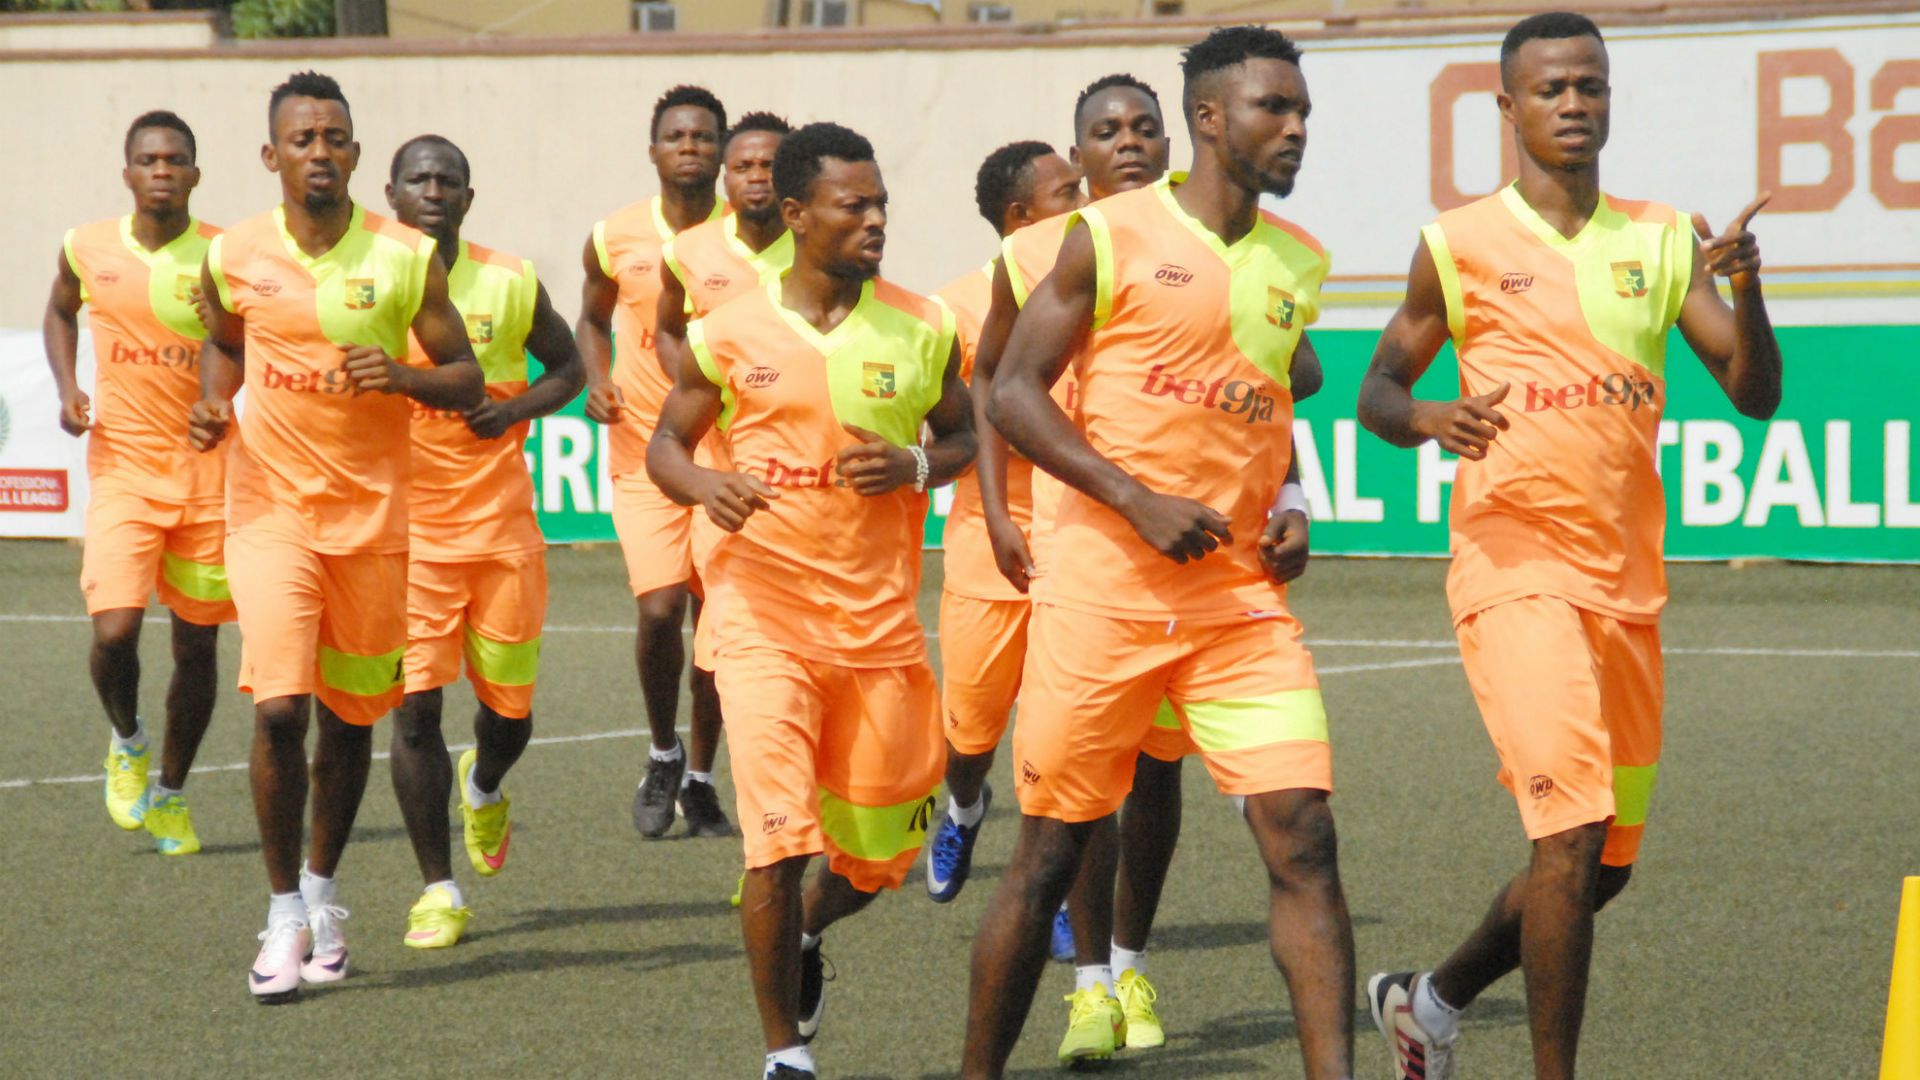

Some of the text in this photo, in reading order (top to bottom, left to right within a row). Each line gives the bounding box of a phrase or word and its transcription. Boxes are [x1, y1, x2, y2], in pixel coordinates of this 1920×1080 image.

[1155, 266, 1194, 285] OWU
[1500, 275, 1534, 292] OWU
[264, 361, 352, 395] bet9
[745, 370, 780, 386] OWU
[1141, 364, 1275, 424] bet9ja
[1524, 373, 1655, 413] bet9ja
[1530, 777, 1553, 797] OWU
[762, 814, 787, 833] OWU
